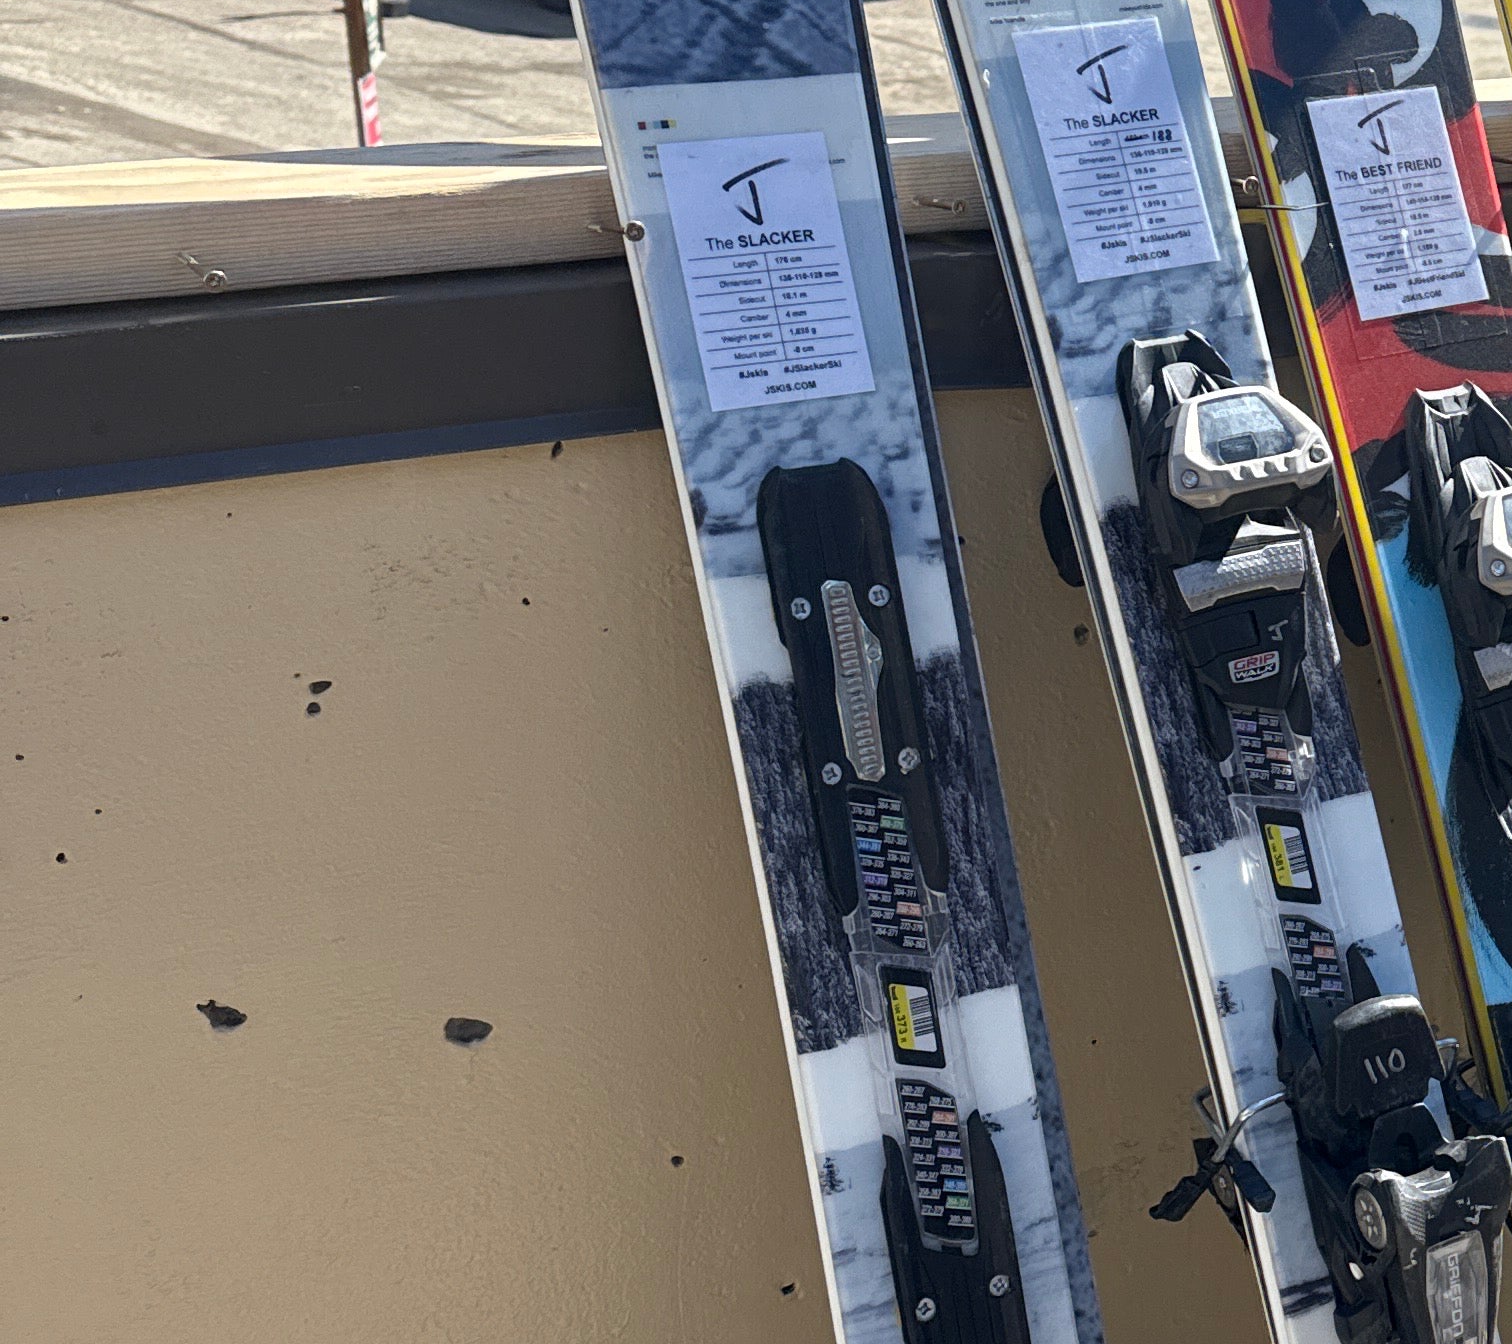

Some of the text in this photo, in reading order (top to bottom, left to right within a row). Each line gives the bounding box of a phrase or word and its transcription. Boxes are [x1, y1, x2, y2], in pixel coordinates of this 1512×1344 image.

[1077, 44, 1128, 104] J
[1064, 109, 1159, 130] The SLACKER
[1358, 100, 1404, 155] J
[1089, 138, 1111, 147] Length
[1079, 155, 1115, 165] Dimensions
[1096, 172, 1120, 180] Sidecut
[1336, 157, 1442, 181] The BEST FRIEND
[722, 158, 790, 225] J
[705, 229, 814, 251] The SLACKER
[733, 259, 758, 269] Length
[1125, 250, 1170, 263] JSKIS.COM
[719, 278, 762, 288] Dimensions
[739, 296, 765, 304] Sidecut
[740, 314, 768, 322] Camber
[721, 334, 747, 343] Weight
[749, 333, 760, 341] per
[734, 351, 756, 360] Mount
[759, 349, 776, 359] point
[739, 360, 841, 379] #Jskis #JSlackerSki
[764, 381, 816, 394] JSKIS.COM
[1234, 653, 1275, 670] GRIP
[1235, 663, 1274, 680] WALK
[897, 1015, 908, 1035] 373
[1364, 1048, 1406, 1084] 110
[1447, 1253, 1464, 1339] GRIFFON
